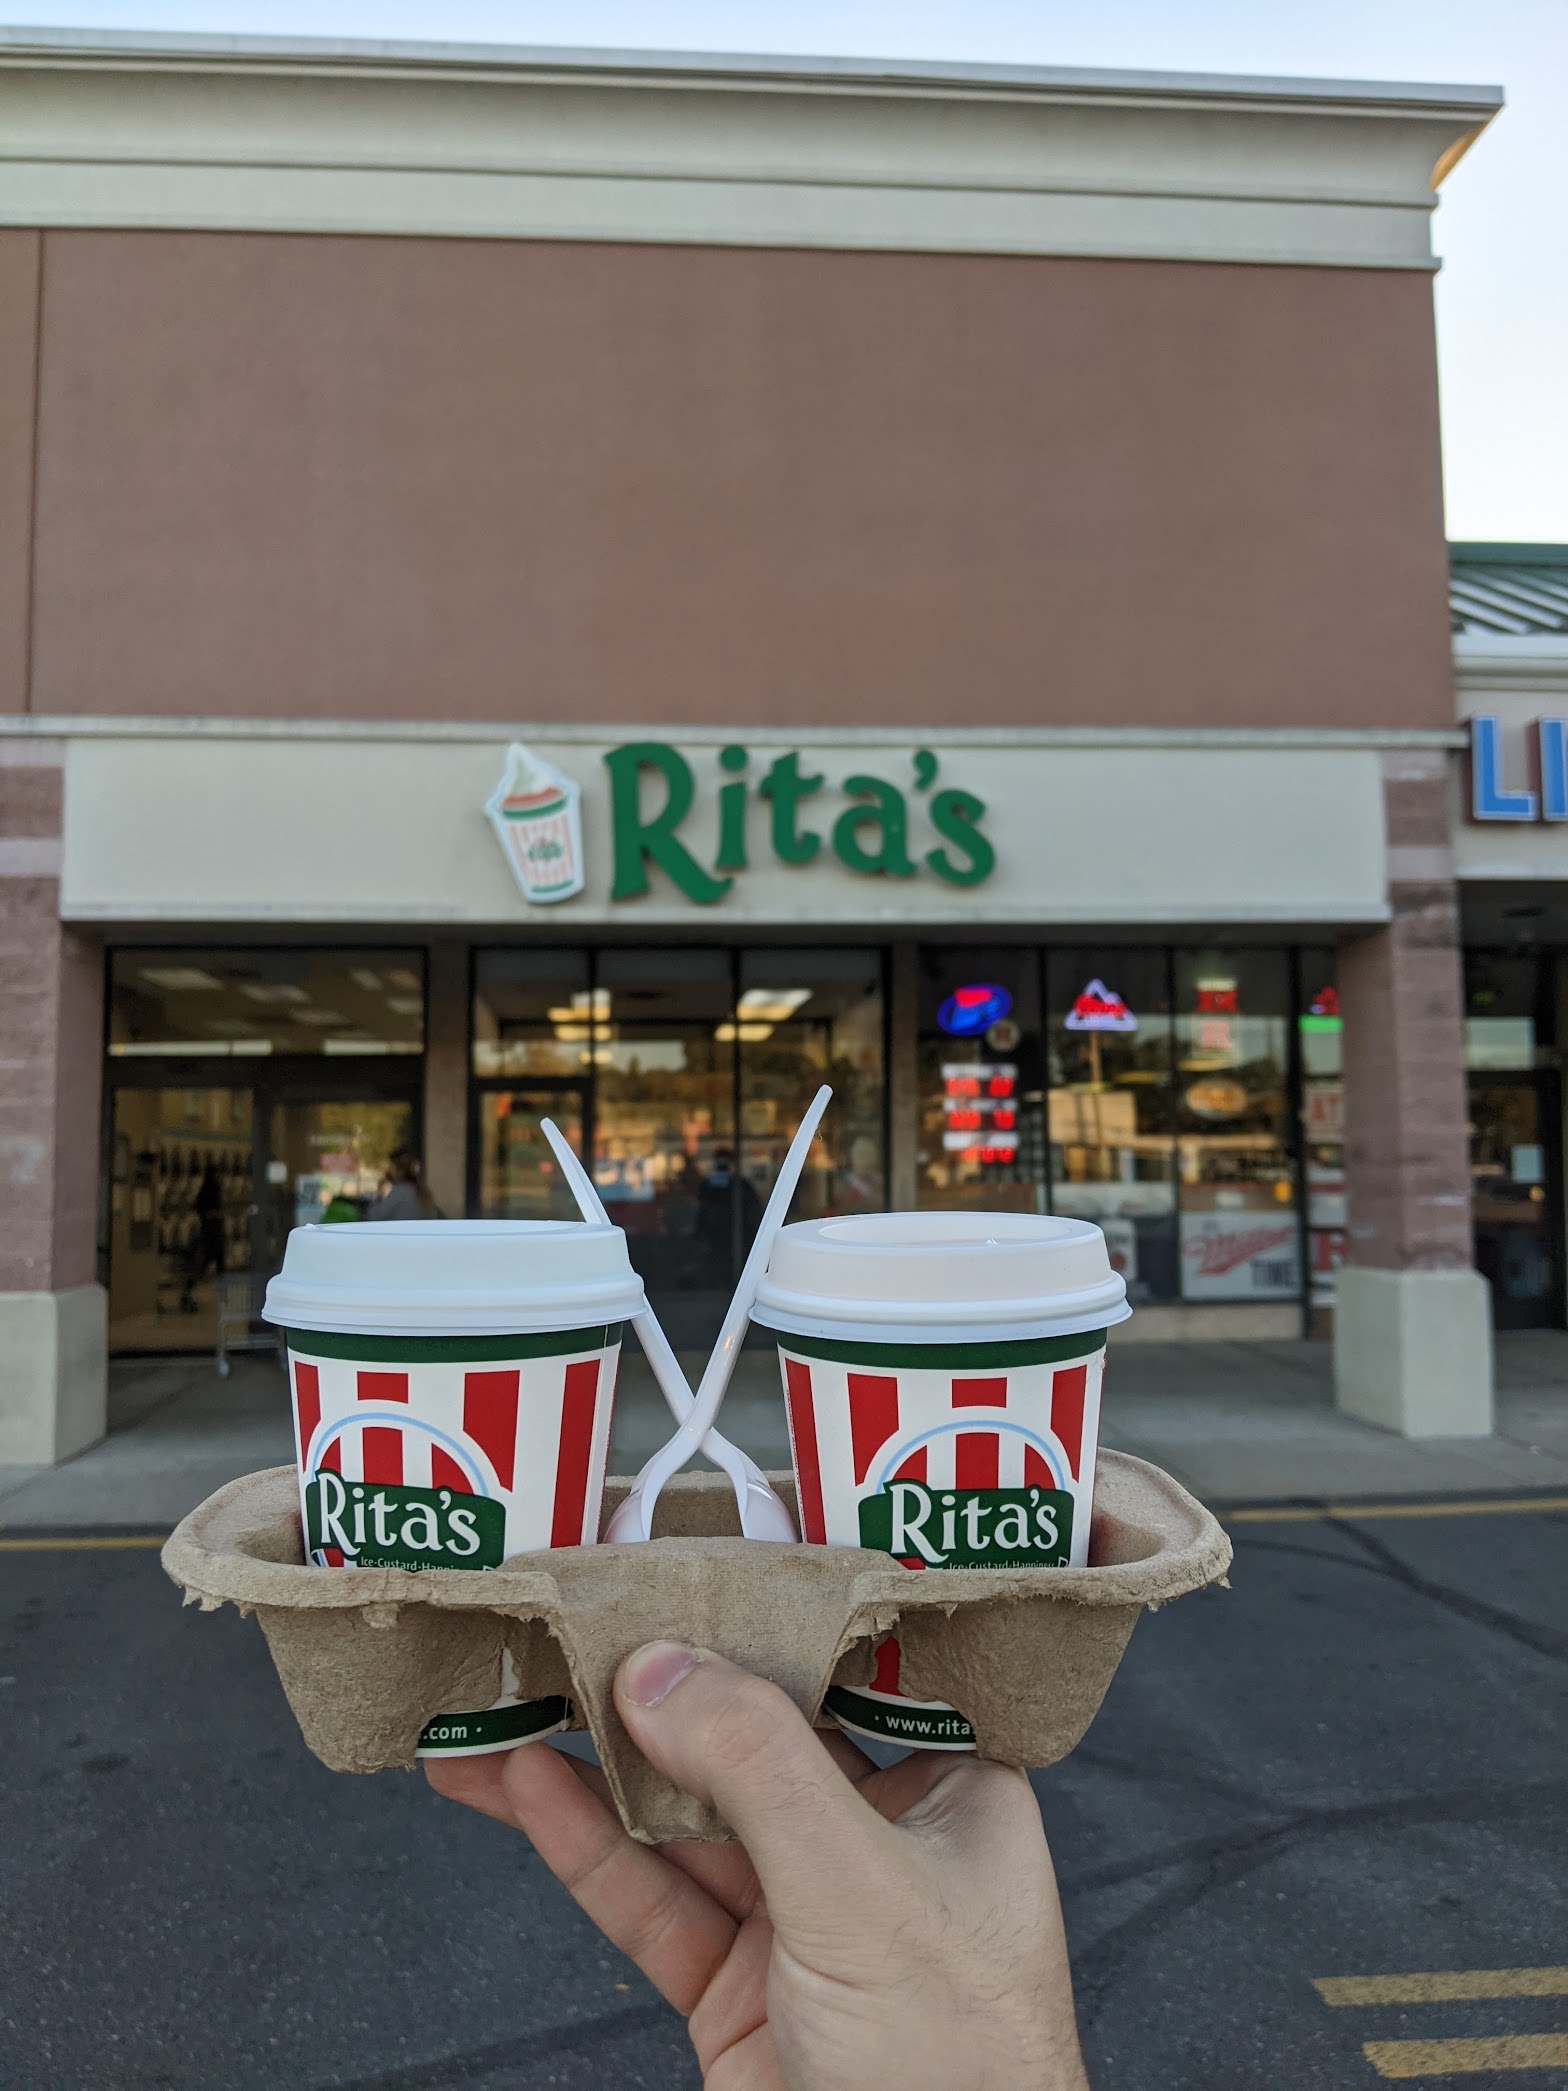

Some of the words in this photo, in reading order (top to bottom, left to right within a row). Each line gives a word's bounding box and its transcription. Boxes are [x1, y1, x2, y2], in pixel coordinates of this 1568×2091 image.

[604, 742, 995, 905] Rita's
[317, 1472, 481, 1556] Rita's
[889, 1483, 1059, 1563] Rita's
[420, 1726, 467, 1740] .com
[885, 1715, 975, 1735] www.rita
